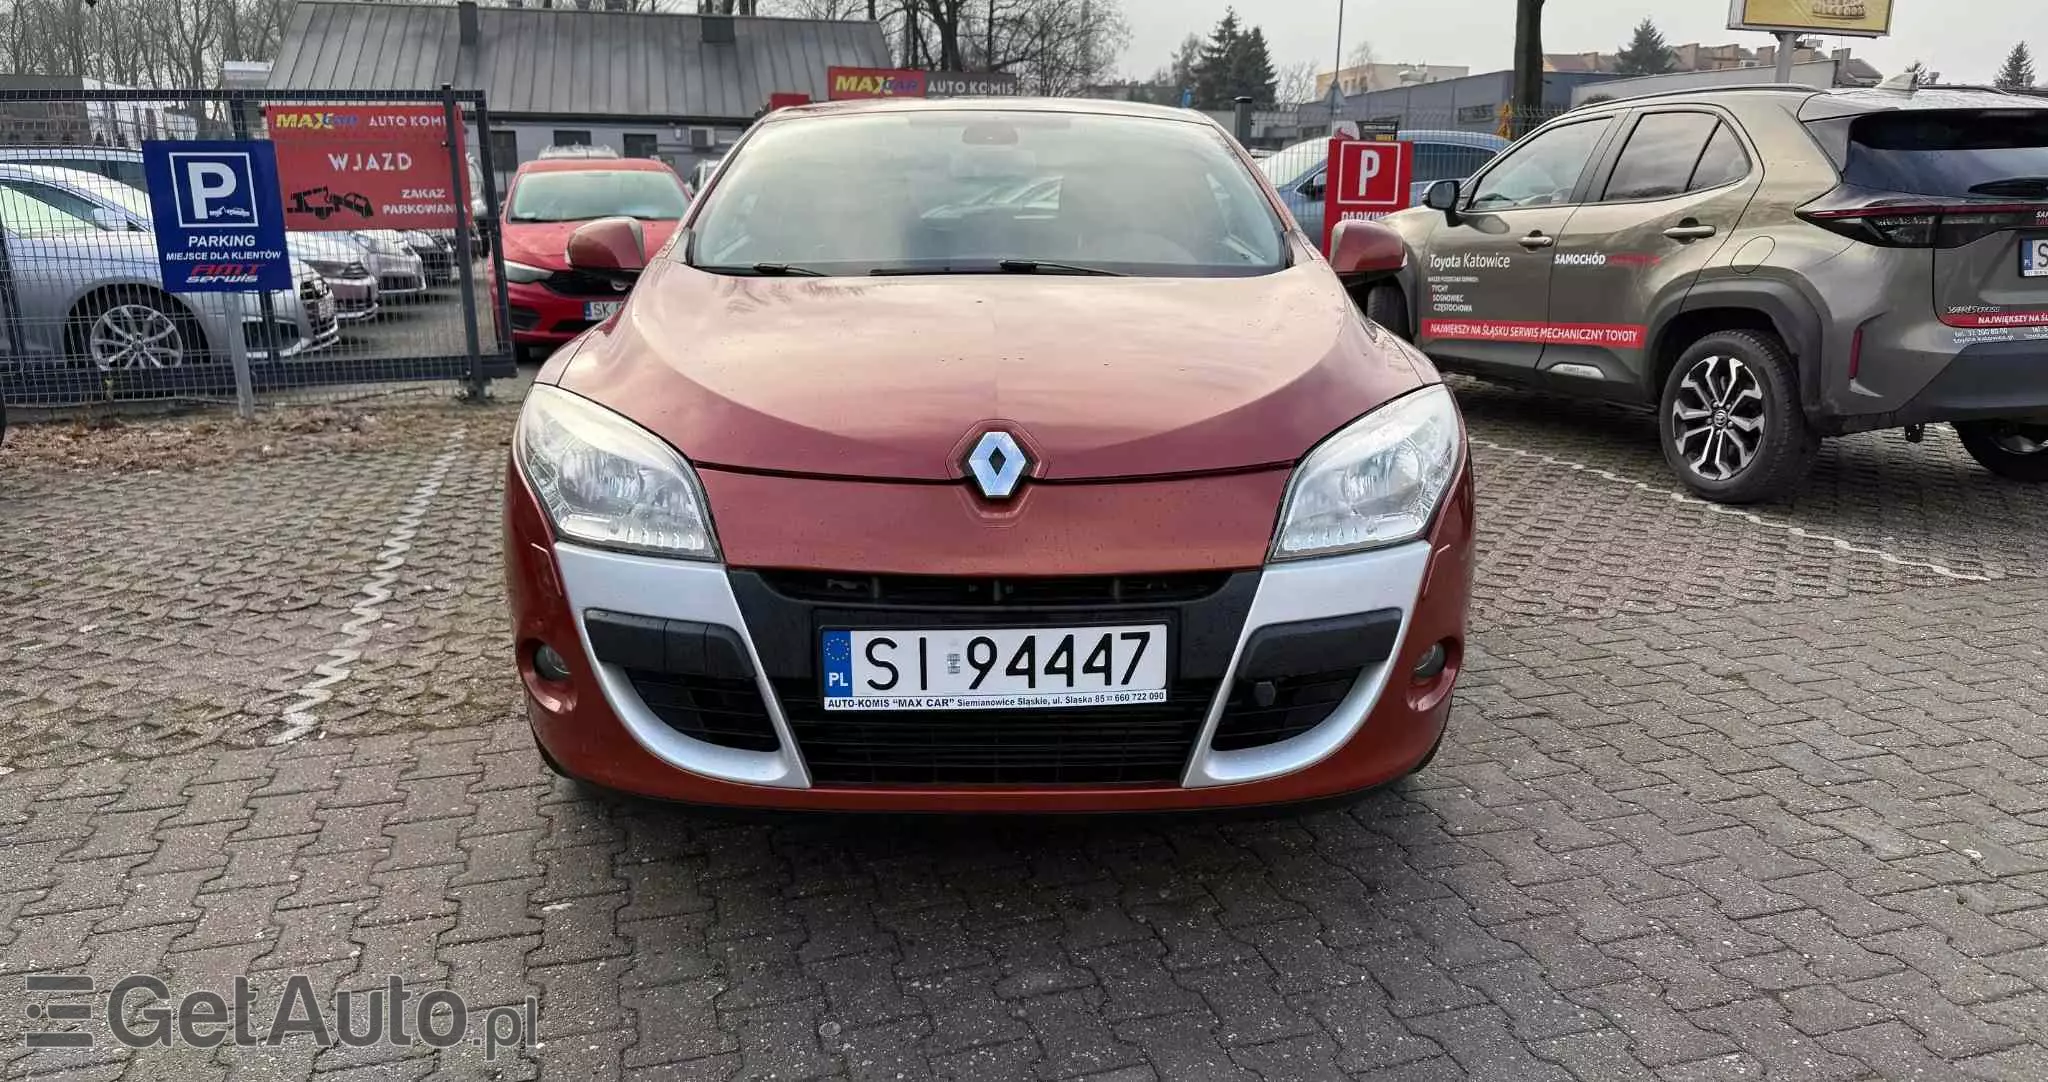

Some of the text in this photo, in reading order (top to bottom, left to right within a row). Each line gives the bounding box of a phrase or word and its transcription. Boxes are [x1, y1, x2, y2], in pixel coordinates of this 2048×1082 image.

[927, 81, 966, 94] AUTO
[969, 80, 1015, 95] KOMIS
[369, 115, 407, 127] AUTO
[410, 115, 447, 127] KOMI
[328, 153, 413, 171] WJAZD
[1358, 150, 1380, 196] P
[188, 162, 237, 219] P
[401, 188, 447, 199] ZAKAZ
[188, 235, 256, 248] PARKING
[166, 249, 281, 261] MIEJSCE DLA KLIENTÓW
[1430, 252, 1510, 271] Toyota Katowice
[1555, 251, 1605, 265] SAMOCHÓD
[186, 274, 258, 284] serwis
[594, 303, 611, 316] SK
[1978, 315, 2026, 325] NAJWIĘKSZY
[1430, 323, 1637, 342] NAJWIĘKSZY NA ŚLĄSKU SERWIS MECHANICZNY TOYOTY
[865, 631, 1150, 691] SI 94447
[828, 672, 848, 687] PL
[828, 698, 889, 708] AUTO-KOMIS
[957, 697, 1015, 707] Siemianowice
[1052, 695, 1063, 704] ul.
[1115, 693, 1130, 702] 660
[1133, 692, 1147, 701] 722
[1150, 691, 1164, 700] 090
